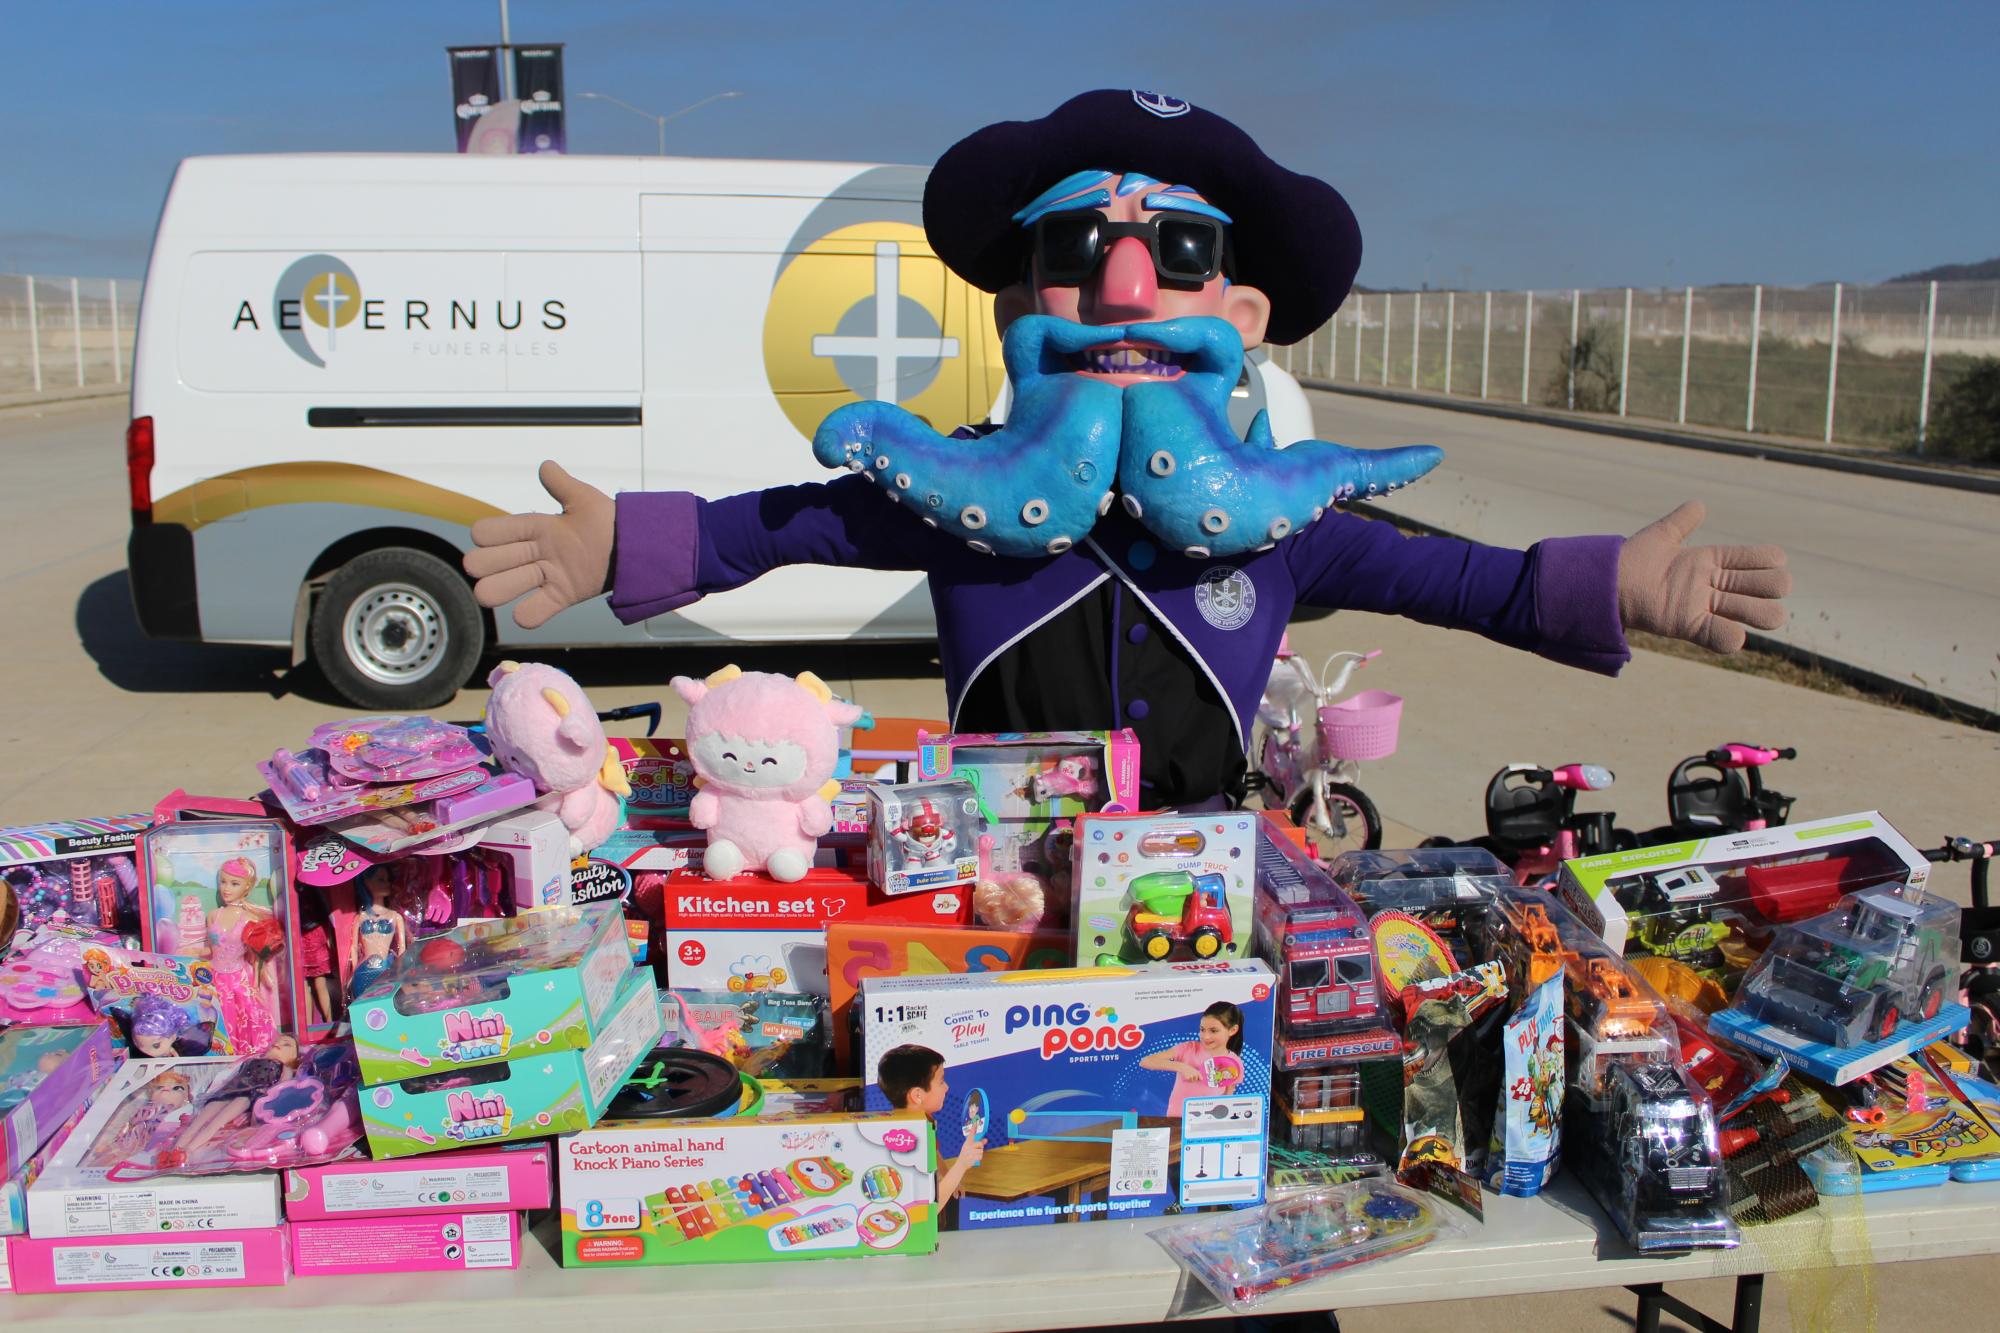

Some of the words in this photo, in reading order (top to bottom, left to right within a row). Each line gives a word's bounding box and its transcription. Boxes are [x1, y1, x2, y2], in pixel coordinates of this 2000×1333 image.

[412, 342, 560, 357] FUNERALES
[69, 837, 101, 847] Beauty
[571, 863, 609, 882] eauty
[1204, 862, 1229, 871] TRUCK
[1581, 858, 1612, 869] FARM
[572, 879, 624, 903] ashion
[678, 896, 769, 913] Kitchen
[777, 897, 814, 913] set
[684, 945, 701, 957] 3+
[112, 975, 191, 1001] Pretty
[875, 1005, 904, 1023] 1:1
[944, 1015, 974, 1026] Come
[977, 1009, 989, 1019] To
[445, 1010, 505, 1044] Nini
[952, 1023, 985, 1042] Play
[1101, 1054, 1119, 1062] TOYS
[1291, 1048, 1327, 1061] FIRE
[1331, 1040, 1394, 1057] RESCUE
[1516, 1083, 1531, 1095] 48
[448, 1091, 505, 1122] Nini
[569, 1142, 629, 1155] Cartoon
[633, 1138, 683, 1152] animal
[687, 1137, 724, 1151] hand
[573, 1158, 618, 1171] Knock
[622, 1156, 661, 1170] Piano
[664, 1155, 704, 1168] Series
[586, 1200, 604, 1227] 8
[604, 1214, 635, 1224] Tone
[969, 1210, 1024, 1222] Experience
[1026, 1208, 1042, 1216] the
[1045, 1206, 1062, 1215] fun
[1063, 1205, 1074, 1213] of
[1076, 1202, 1107, 1214] sports
[1109, 1199, 1151, 1211] together
